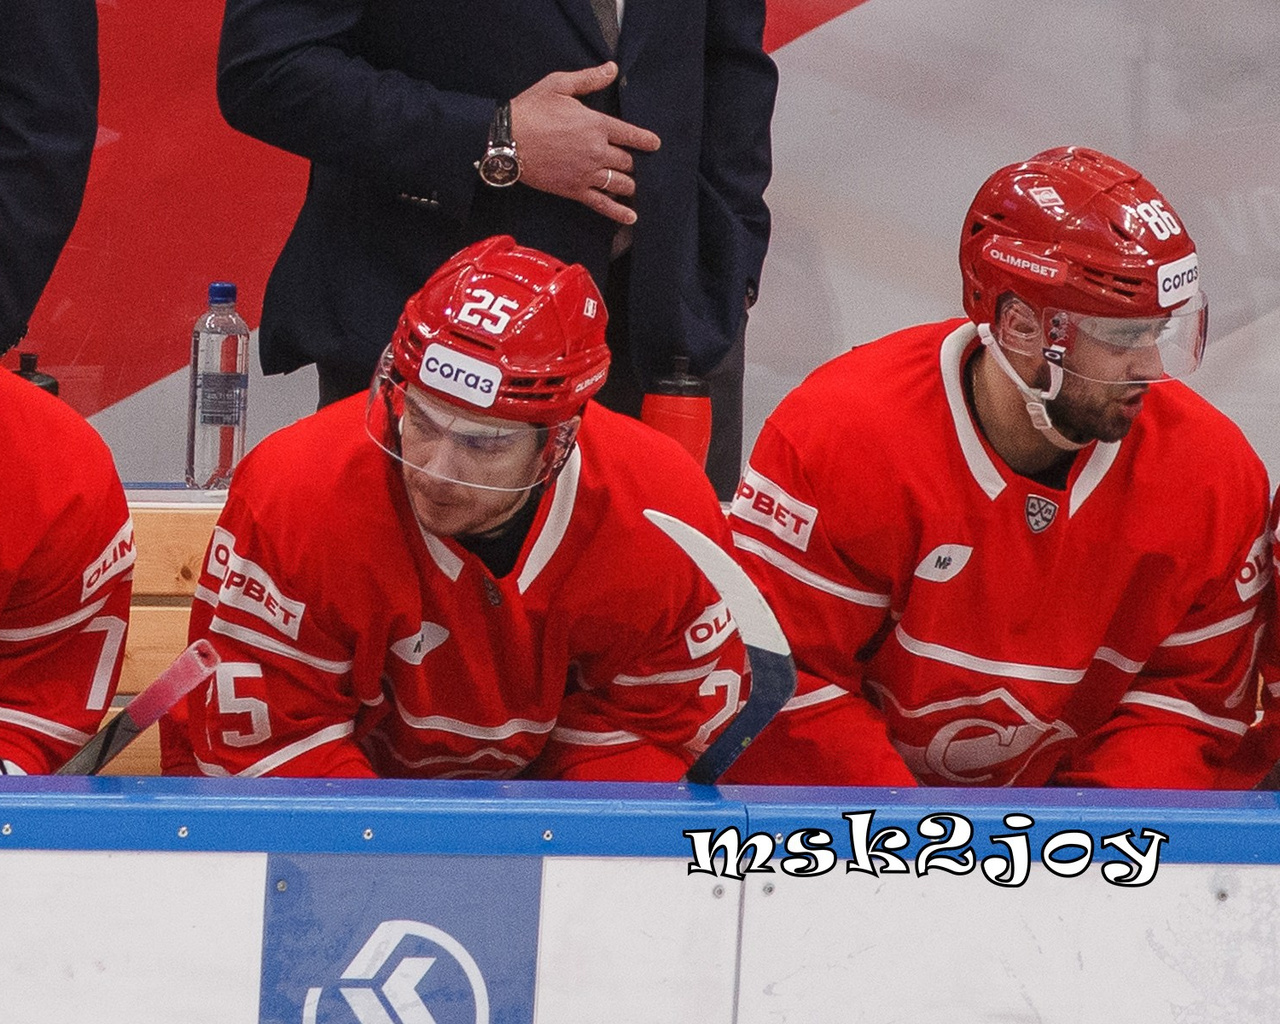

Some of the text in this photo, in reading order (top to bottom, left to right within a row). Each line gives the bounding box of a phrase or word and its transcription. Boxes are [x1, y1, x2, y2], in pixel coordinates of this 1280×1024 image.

[1136, 199, 1182, 241] 86
[989, 249, 1059, 278] OLIMPBET
[457, 288, 519, 334] 25
[425, 356, 495, 394] согаз
